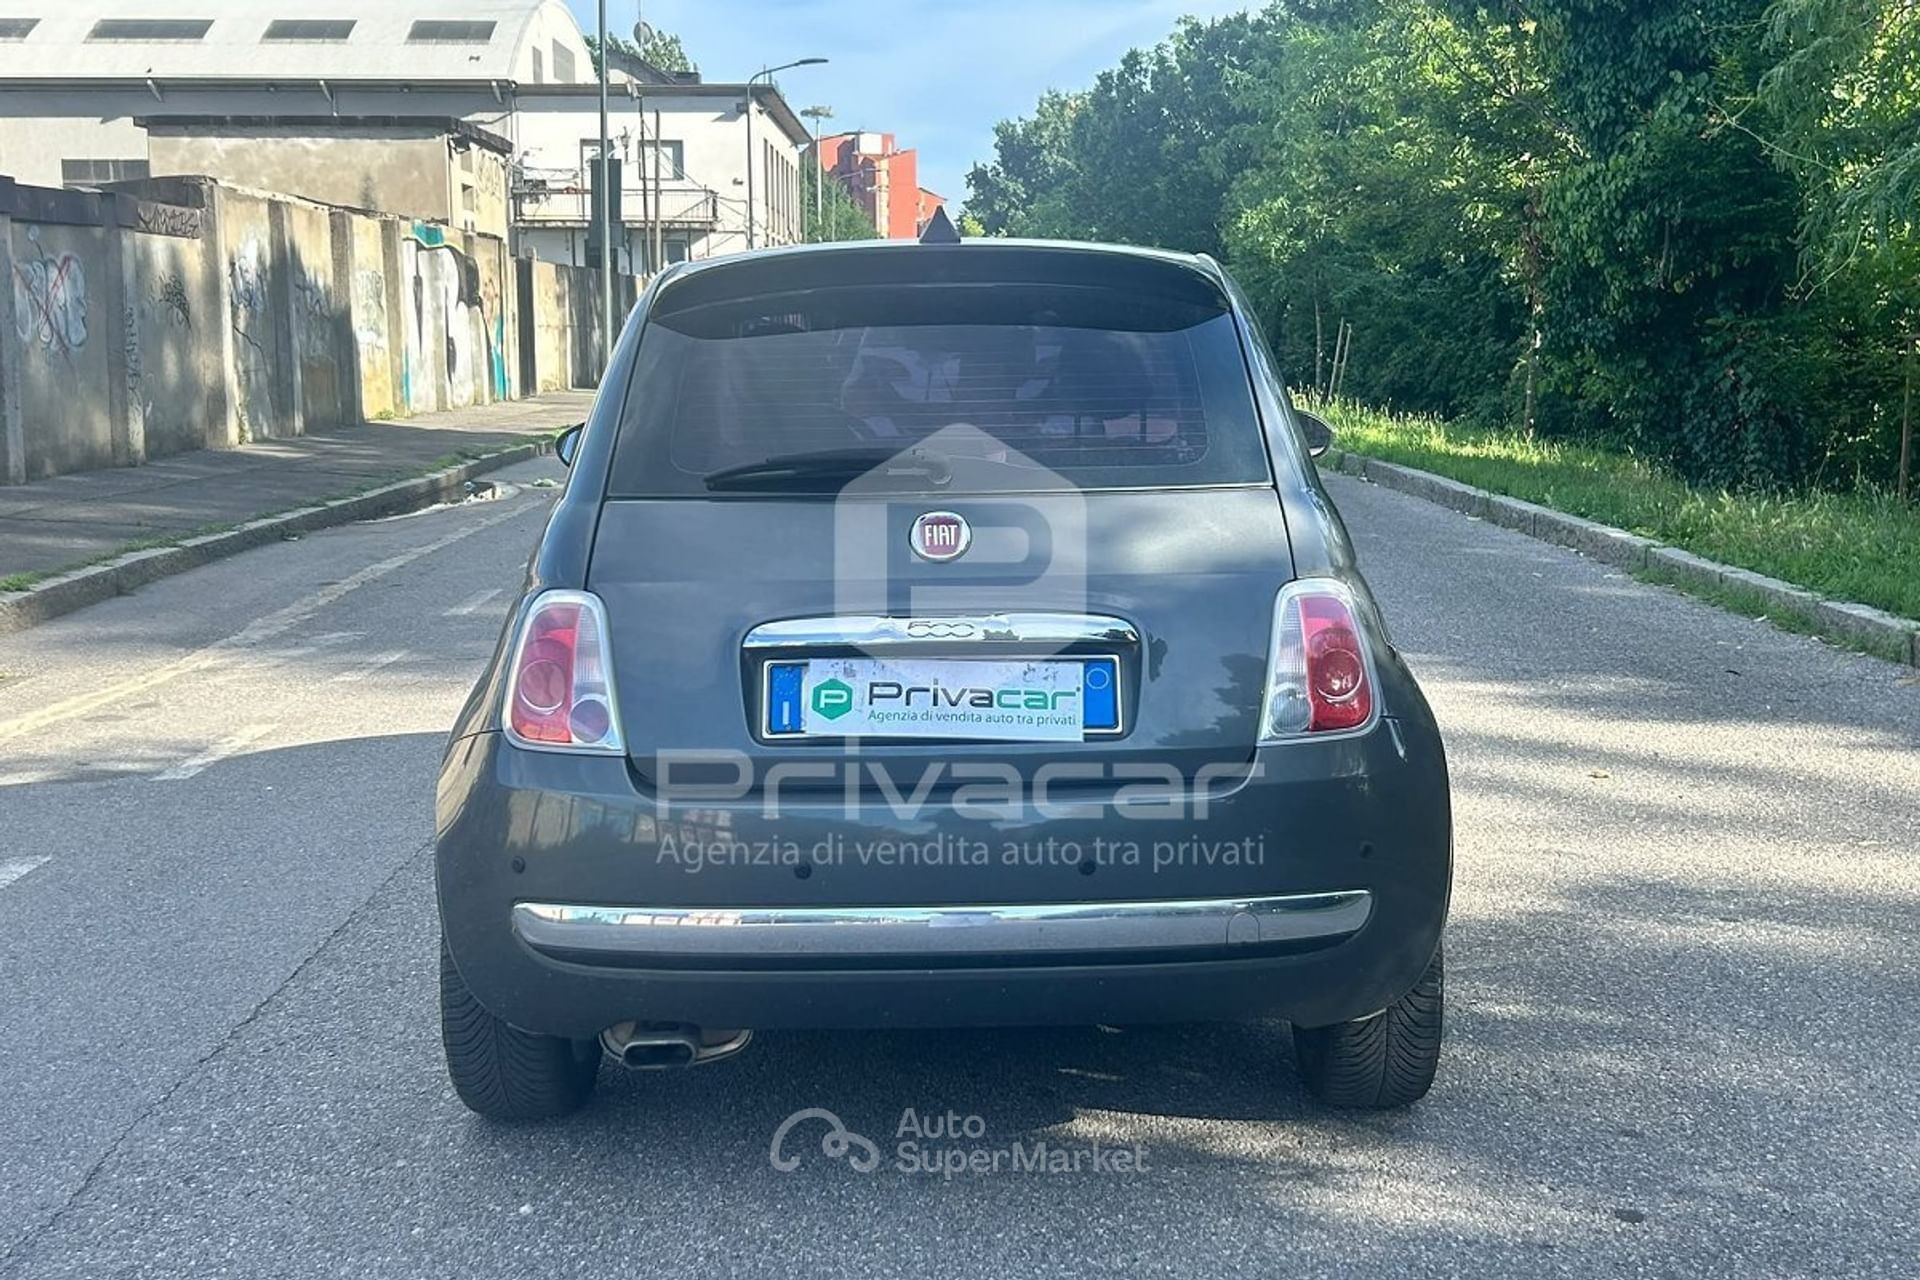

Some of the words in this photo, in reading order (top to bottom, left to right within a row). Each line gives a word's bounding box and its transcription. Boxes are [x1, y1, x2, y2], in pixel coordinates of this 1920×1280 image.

[924, 524, 958, 546] FIAT
[907, 621, 974, 638] 500
[820, 690, 848, 708] P
[782, 701, 790, 724] I
[867, 709, 917, 723] Agenzia
[921, 709, 933, 721] di
[935, 710, 982, 723] vendita
[985, 713, 1014, 724] auto
[1017, 713, 1034, 724] tra
[1037, 713, 1076, 727] privati
